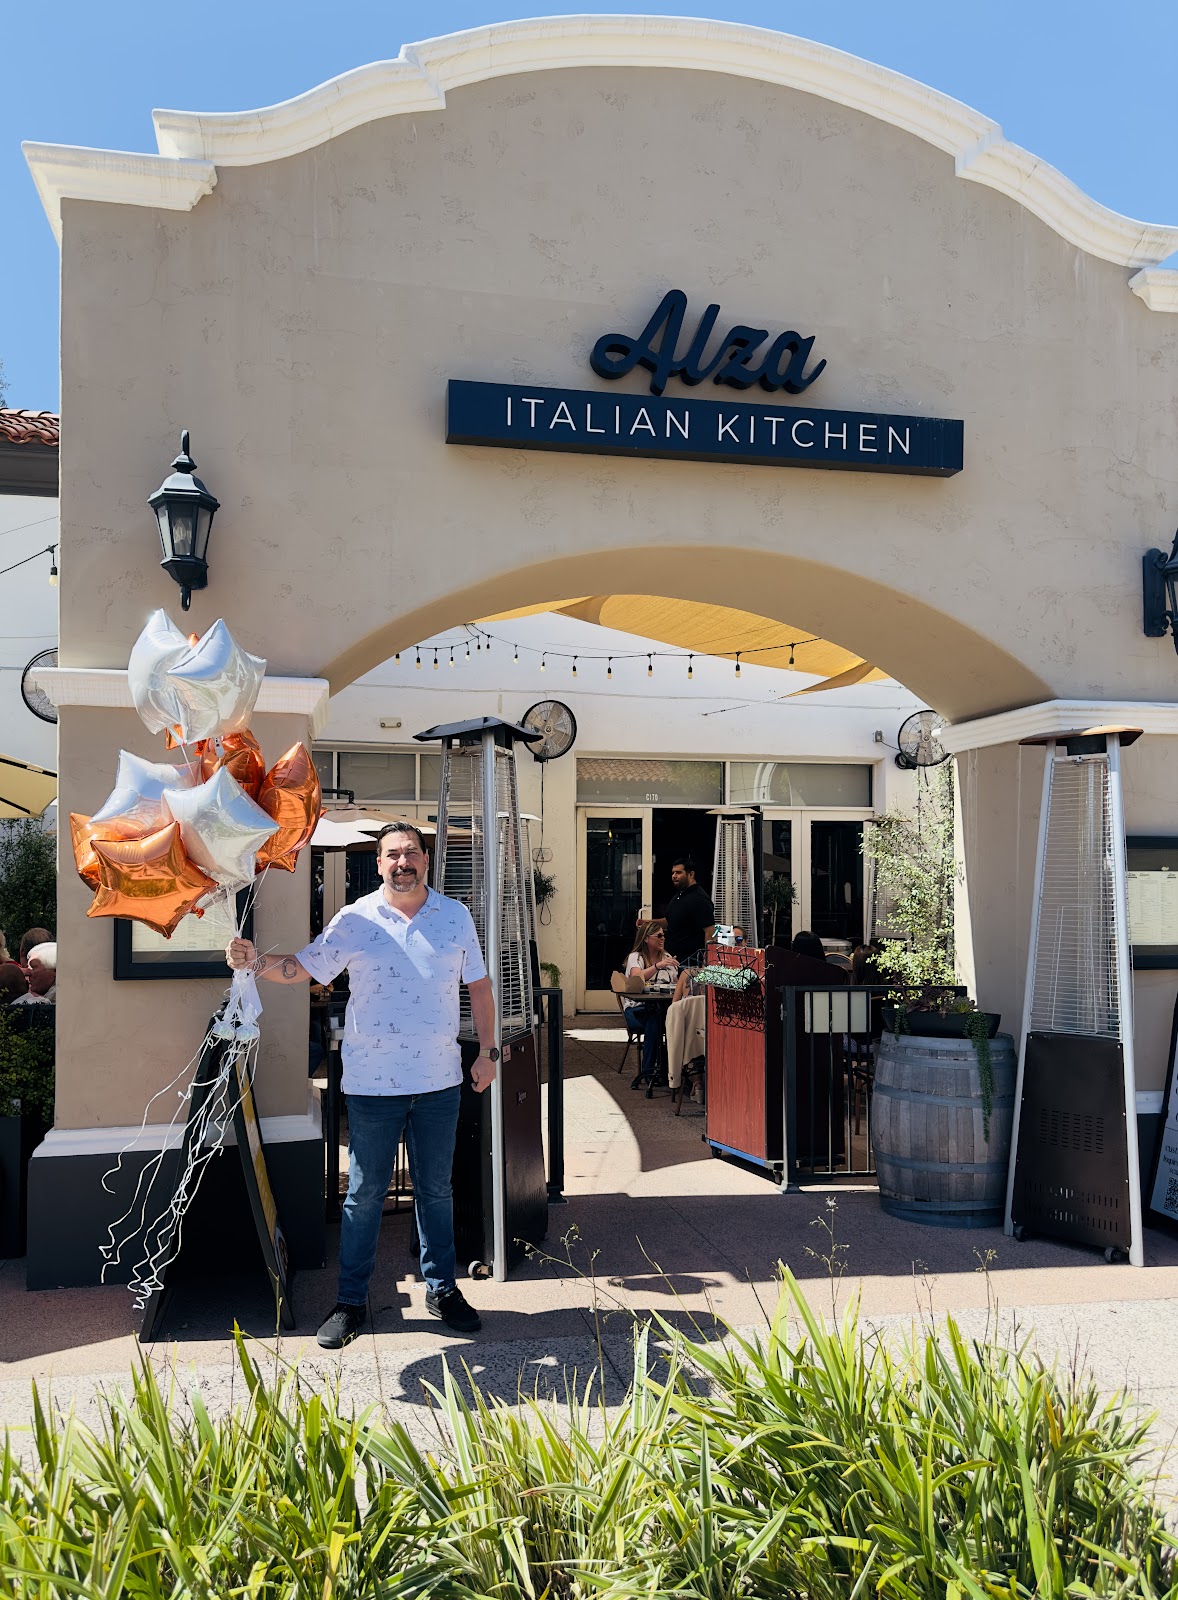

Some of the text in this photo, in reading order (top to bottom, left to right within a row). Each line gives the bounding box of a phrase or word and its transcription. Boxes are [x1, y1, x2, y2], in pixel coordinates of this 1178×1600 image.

[589, 288, 828, 397] Alza
[505, 396, 911, 455] ITALIAN KITCHEN
